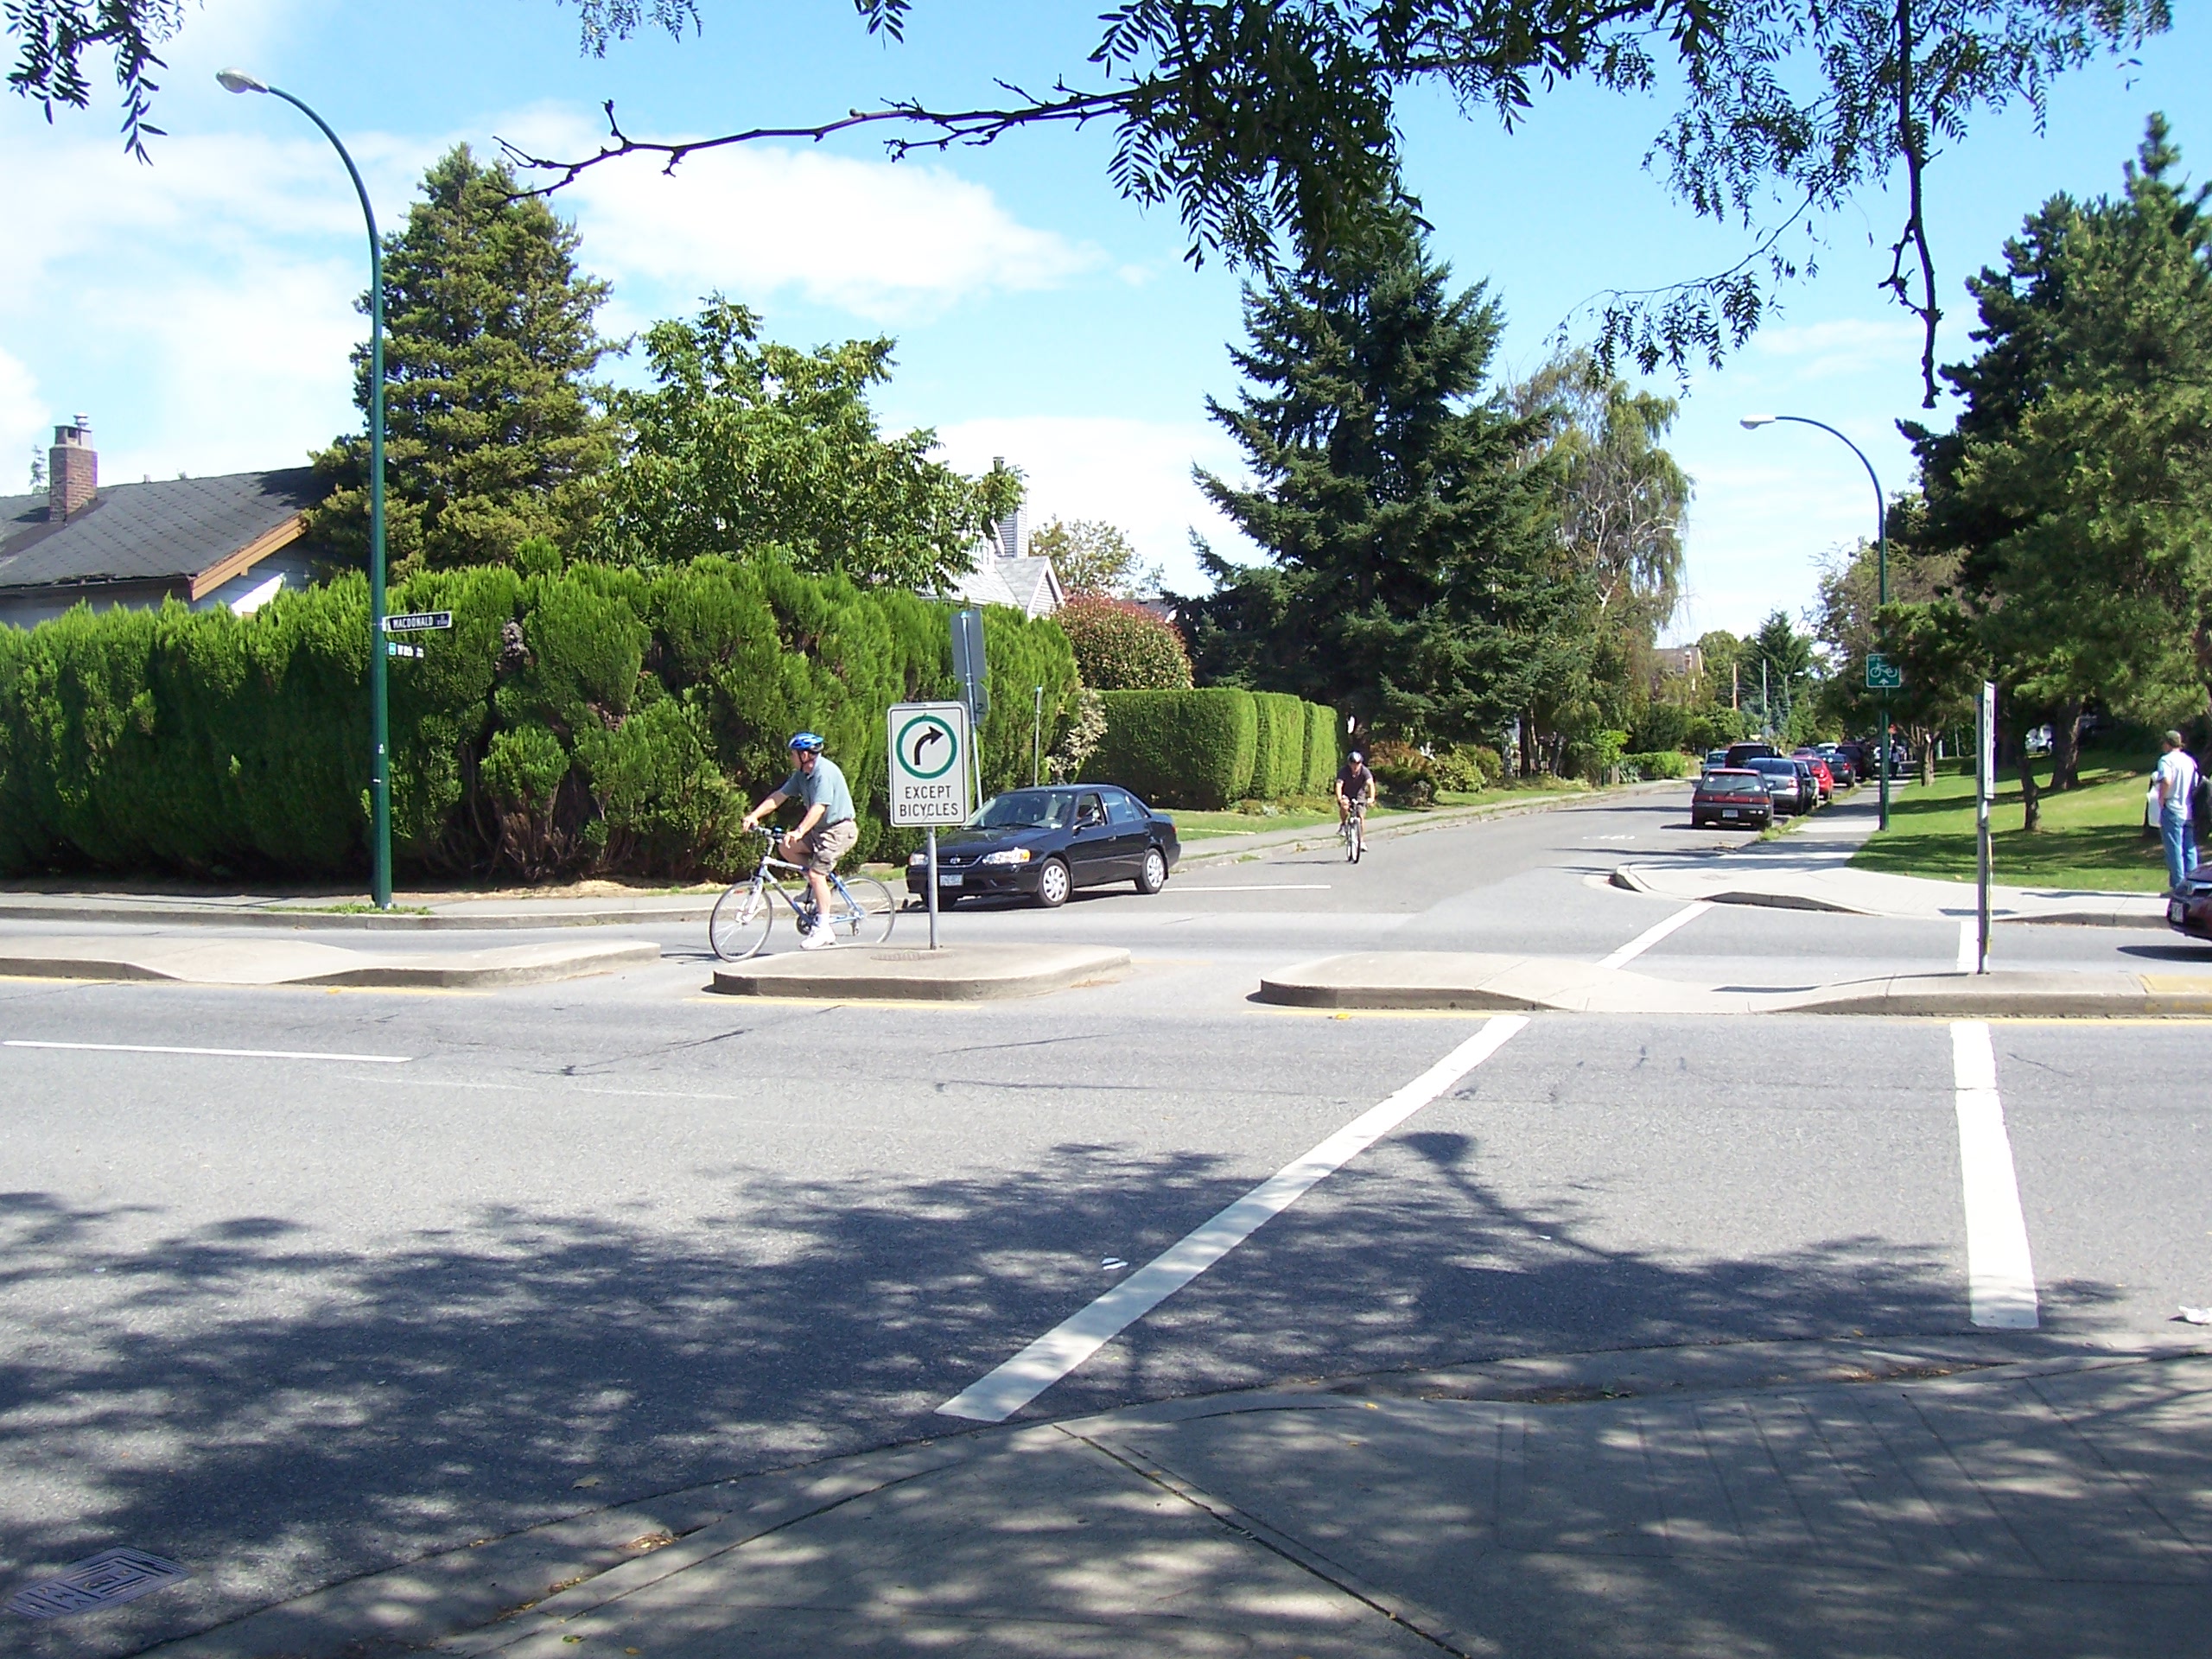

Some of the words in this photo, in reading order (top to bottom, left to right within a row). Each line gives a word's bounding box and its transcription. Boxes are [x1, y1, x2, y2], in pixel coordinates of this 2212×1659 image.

[392, 616, 434, 629] MACDONALD
[905, 785, 952, 799] EXCEPT
[899, 803, 958, 817] BICYCLES
